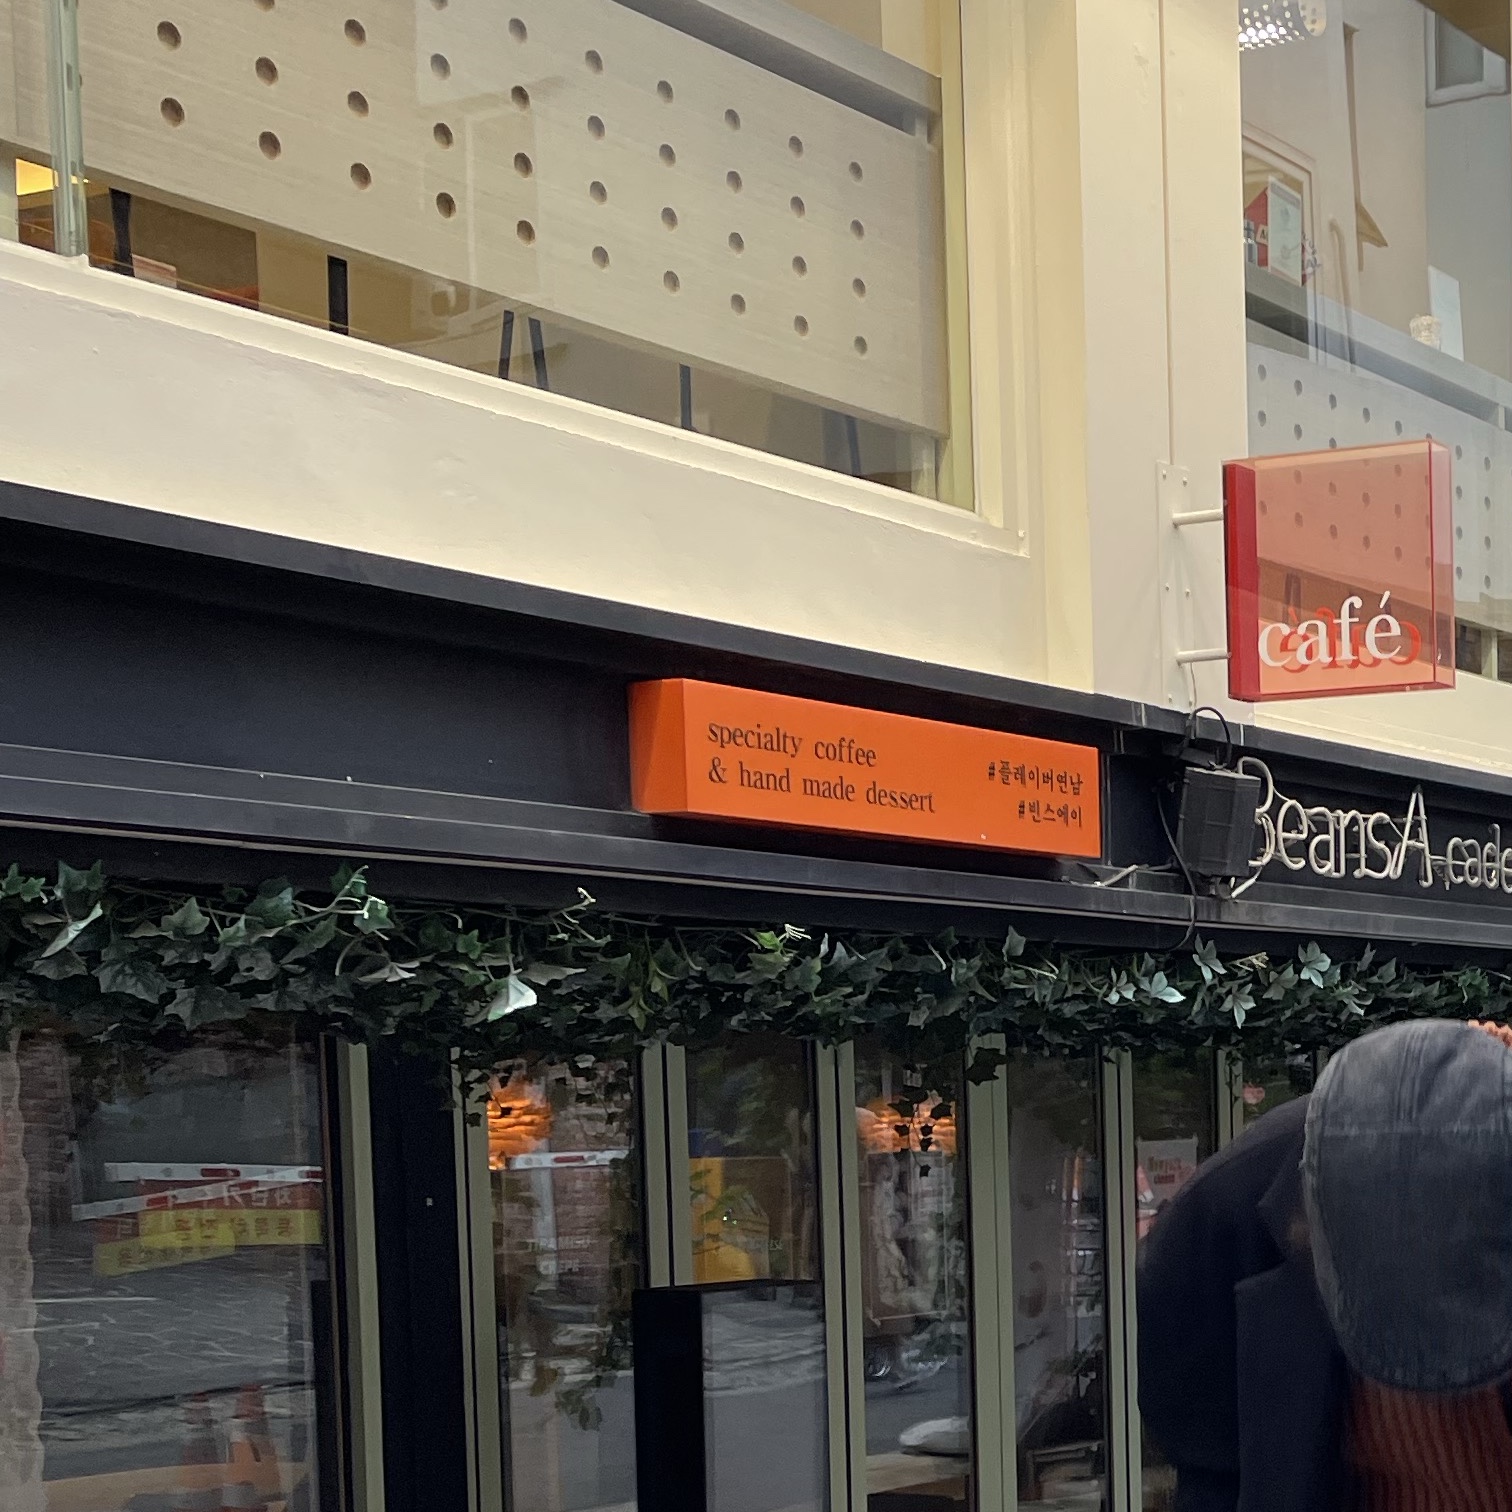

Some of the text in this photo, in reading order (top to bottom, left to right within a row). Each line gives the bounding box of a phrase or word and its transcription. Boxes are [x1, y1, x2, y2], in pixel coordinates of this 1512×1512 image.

[1258, 590, 1401, 667] café
[707, 722, 877, 767] specialty coffee
[708, 755, 936, 814] & hand made dessert
[988, 760, 1083, 796] #플레이버연남
[1018, 800, 1083, 828] #빈스에이
